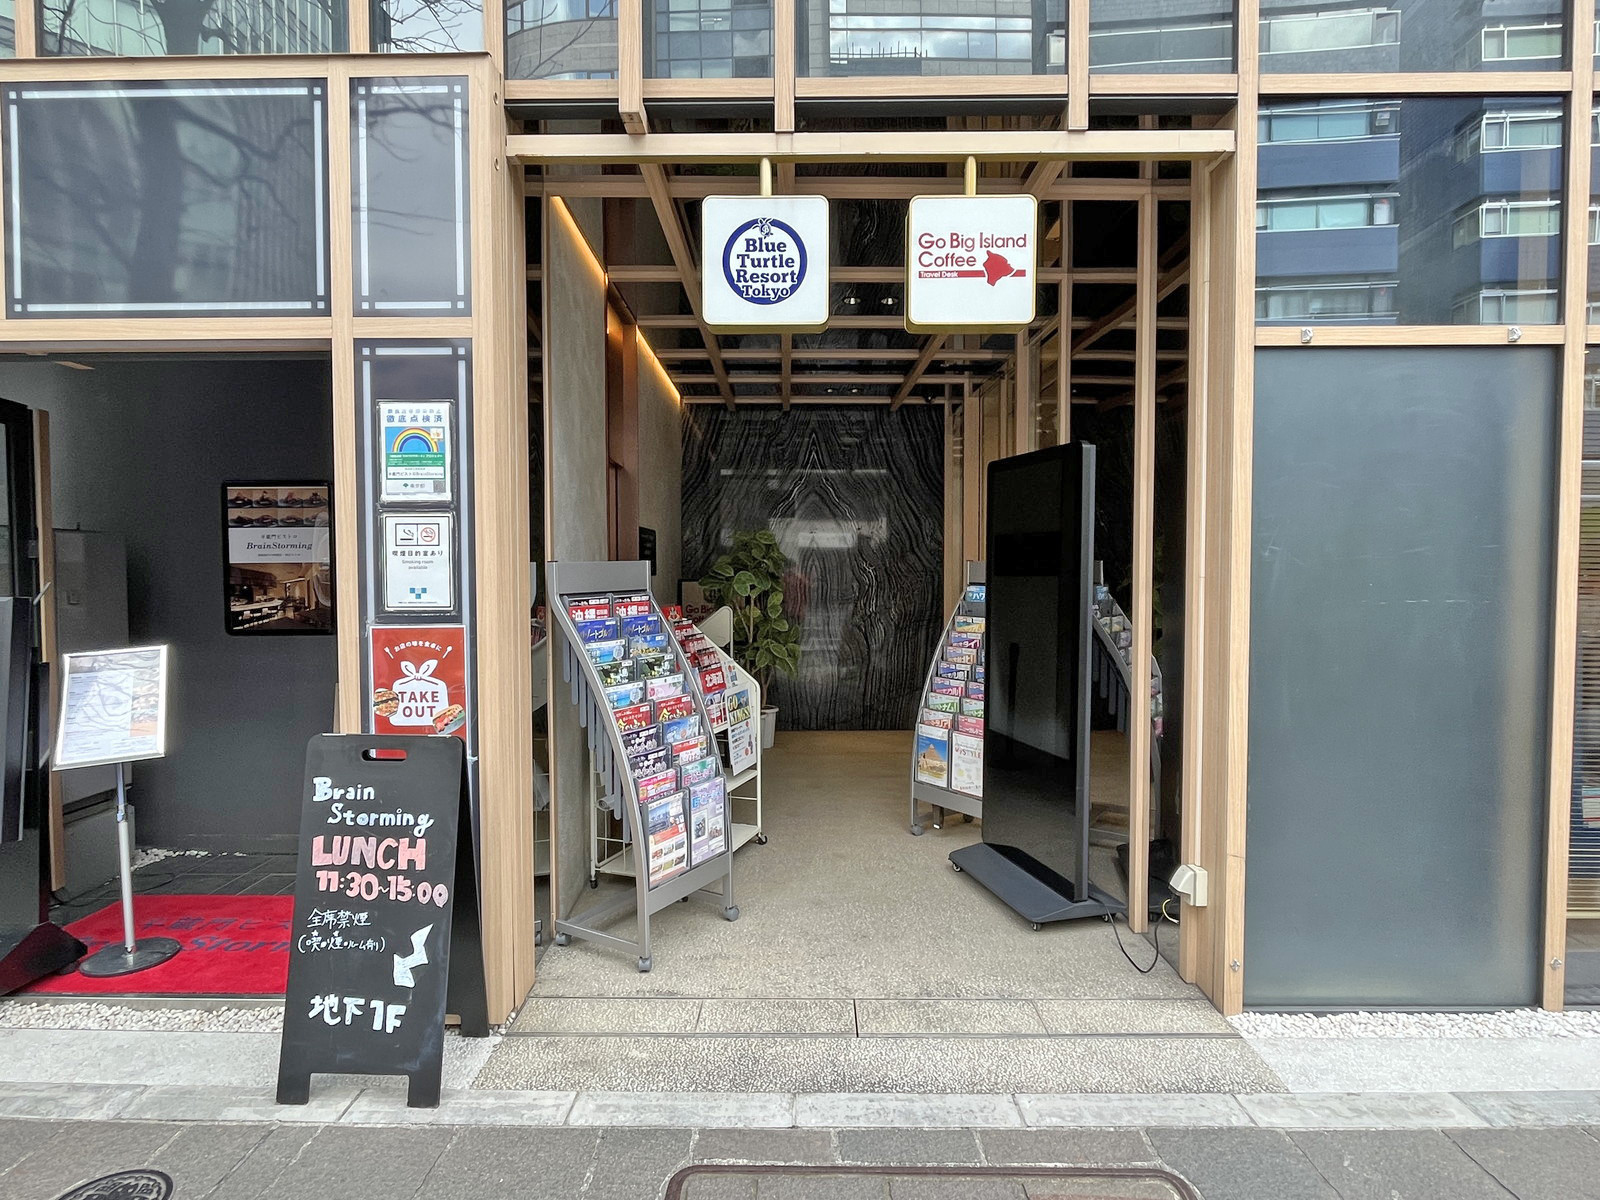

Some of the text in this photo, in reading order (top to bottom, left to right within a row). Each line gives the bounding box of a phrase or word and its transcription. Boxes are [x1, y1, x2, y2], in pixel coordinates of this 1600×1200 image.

[744, 238, 786, 252] Blue
[918, 232, 1027, 252] Go Big Island
[736, 254, 795, 268] Turtle
[918, 251, 977, 267] Coffee
[735, 269, 797, 284] Resort
[741, 284, 790, 299] Tokyo
[246, 542, 313, 550] BrainStorming
[398, 691, 440, 703] TAKE
[402, 705, 436, 718] OUT
[312, 776, 375, 801] Brain
[327, 803, 434, 837] Storming
[311, 835, 427, 871] LUNCH
[307, 908, 371, 930] 全席禁煙
